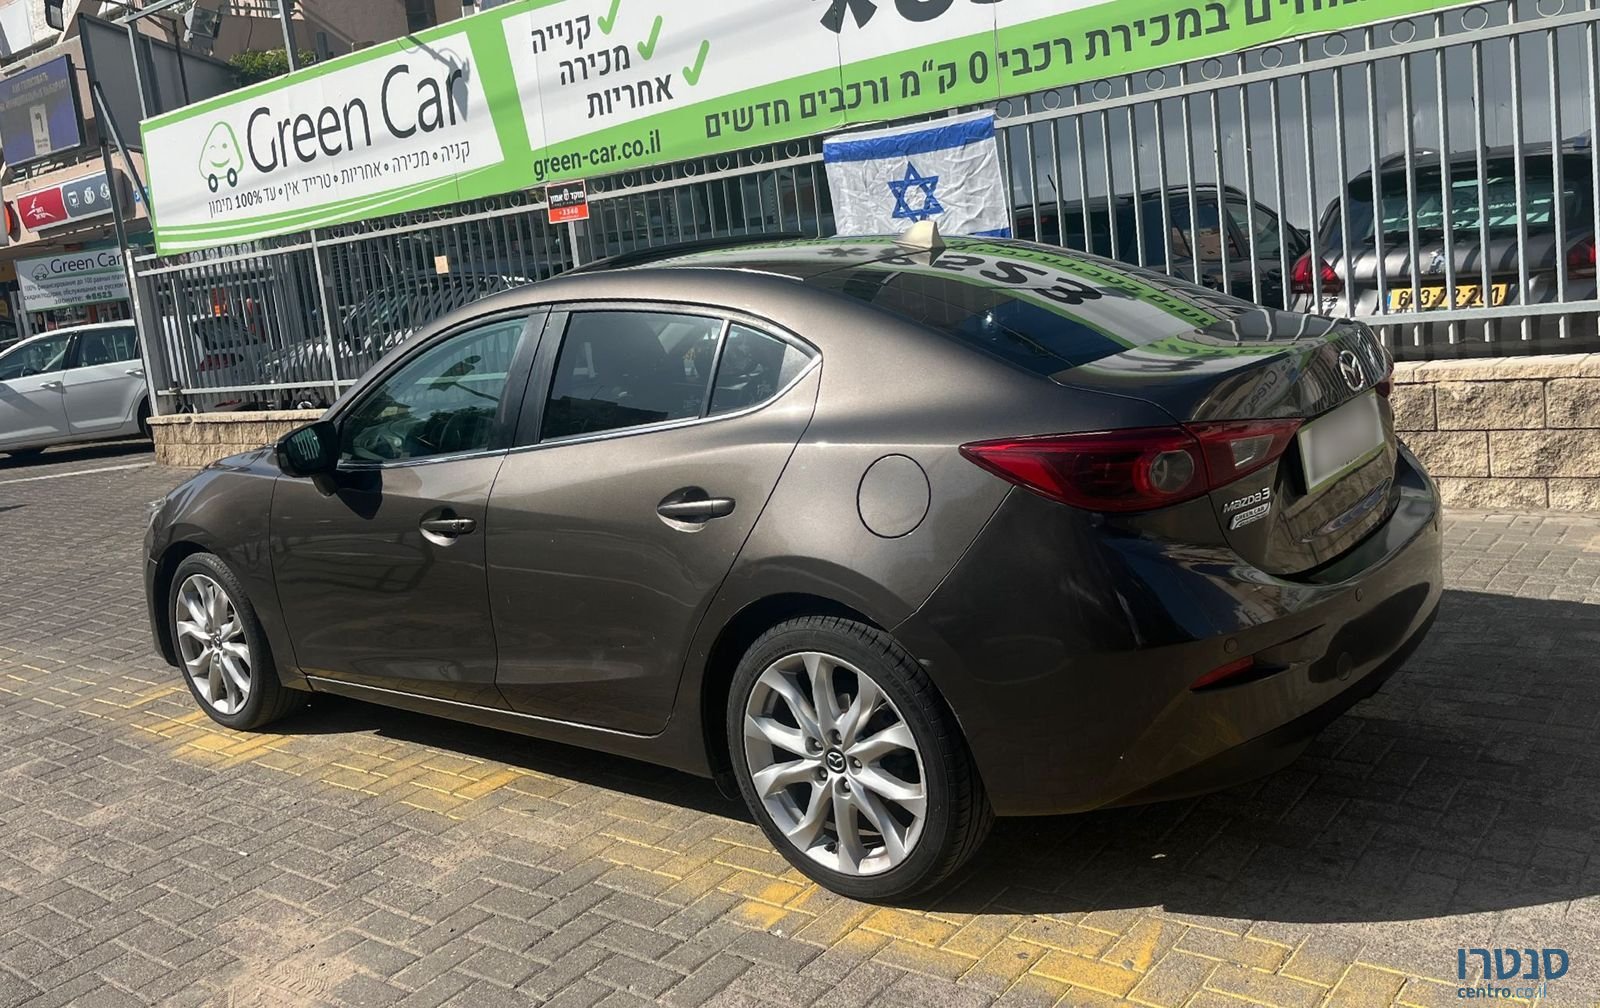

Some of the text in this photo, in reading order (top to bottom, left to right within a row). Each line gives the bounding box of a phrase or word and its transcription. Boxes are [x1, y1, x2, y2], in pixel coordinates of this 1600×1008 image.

[531, 14, 591, 54] קנייה
[1085, 1, 1230, 61] במכירת
[559, 44, 631, 86] מכירה
[969, 50, 988, 85] 0
[998, 36, 1073, 77] רכבי
[587, 74, 674, 119] אחריות
[800, 75, 890, 119] ורכבים
[246, 64, 463, 174] Green Car
[705, 98, 790, 139] חדשים
[533, 128, 662, 181] green-car.co.il
[208, 140, 470, 218] קניה מכירה אחריות טרייד אין עד 100% מימון
[50, 252, 122, 274] Green Car
